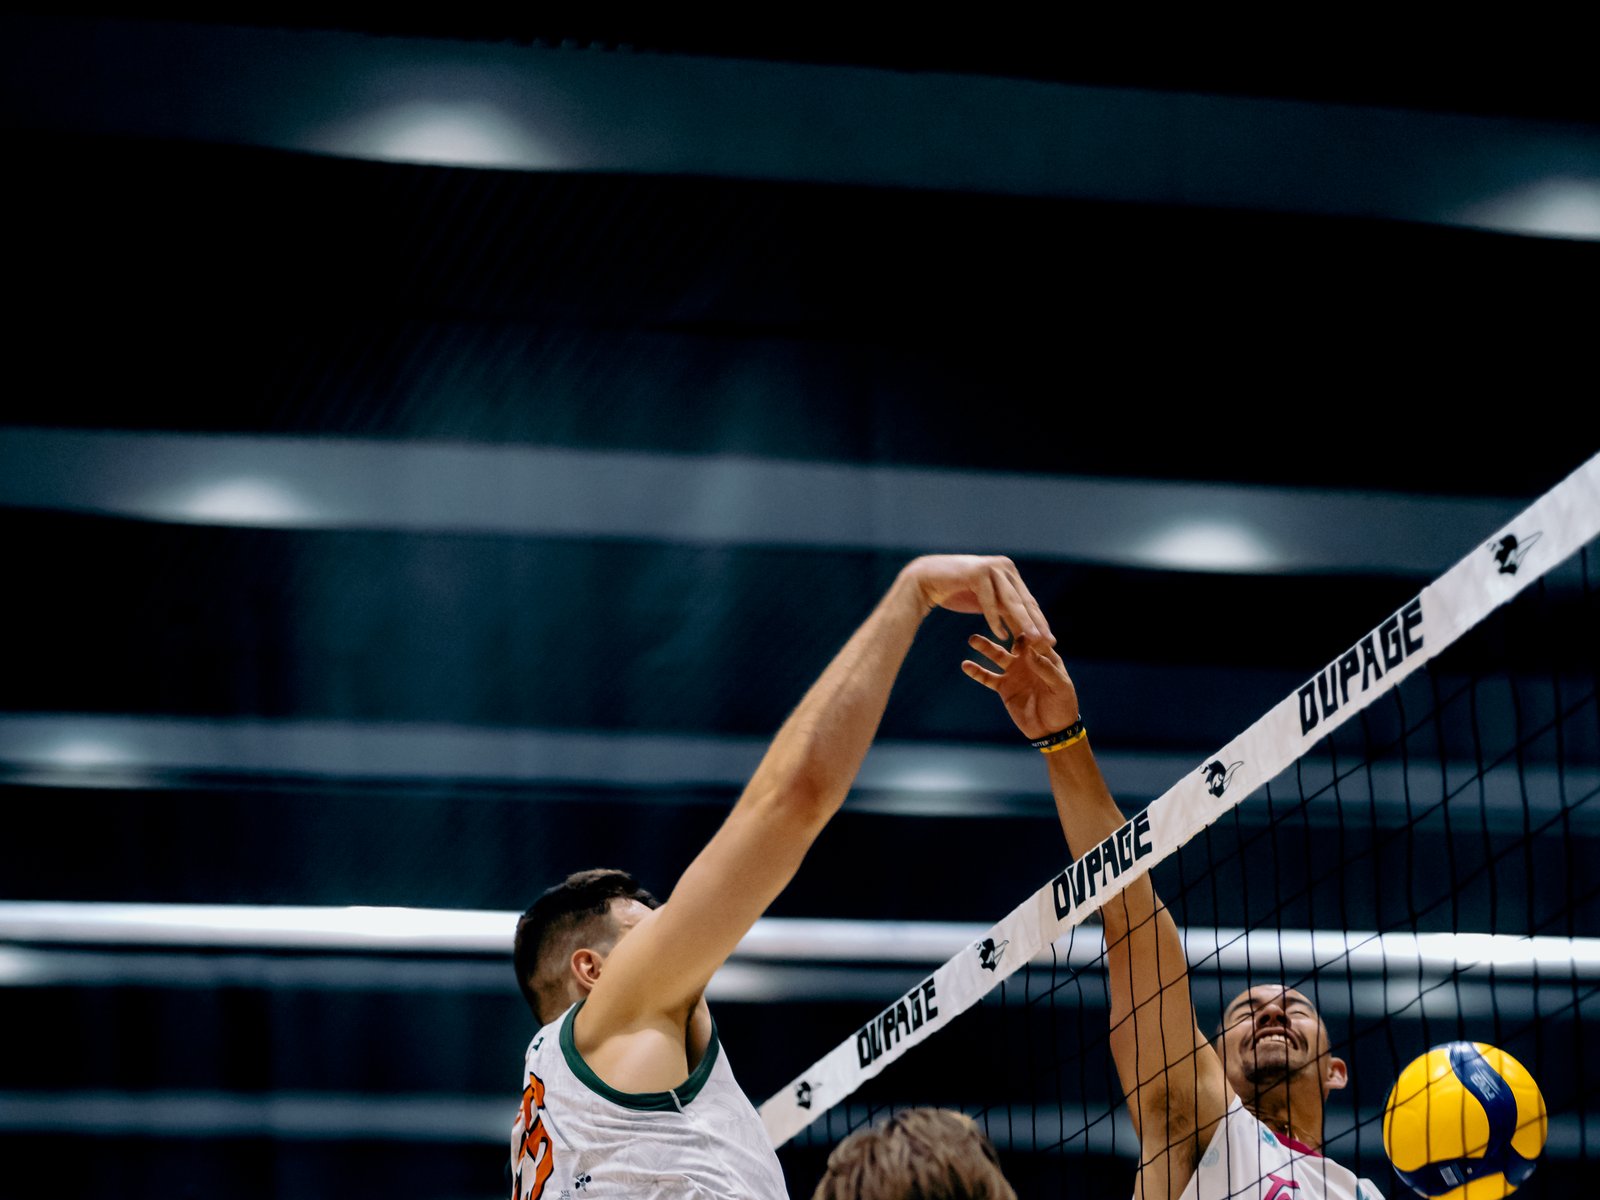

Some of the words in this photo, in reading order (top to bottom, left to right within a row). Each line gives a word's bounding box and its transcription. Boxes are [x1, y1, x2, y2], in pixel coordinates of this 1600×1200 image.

[1298, 595, 1424, 737] DUPAGE
[1052, 809, 1153, 921] DUPAGE
[857, 976, 939, 1069] DUPAGE
